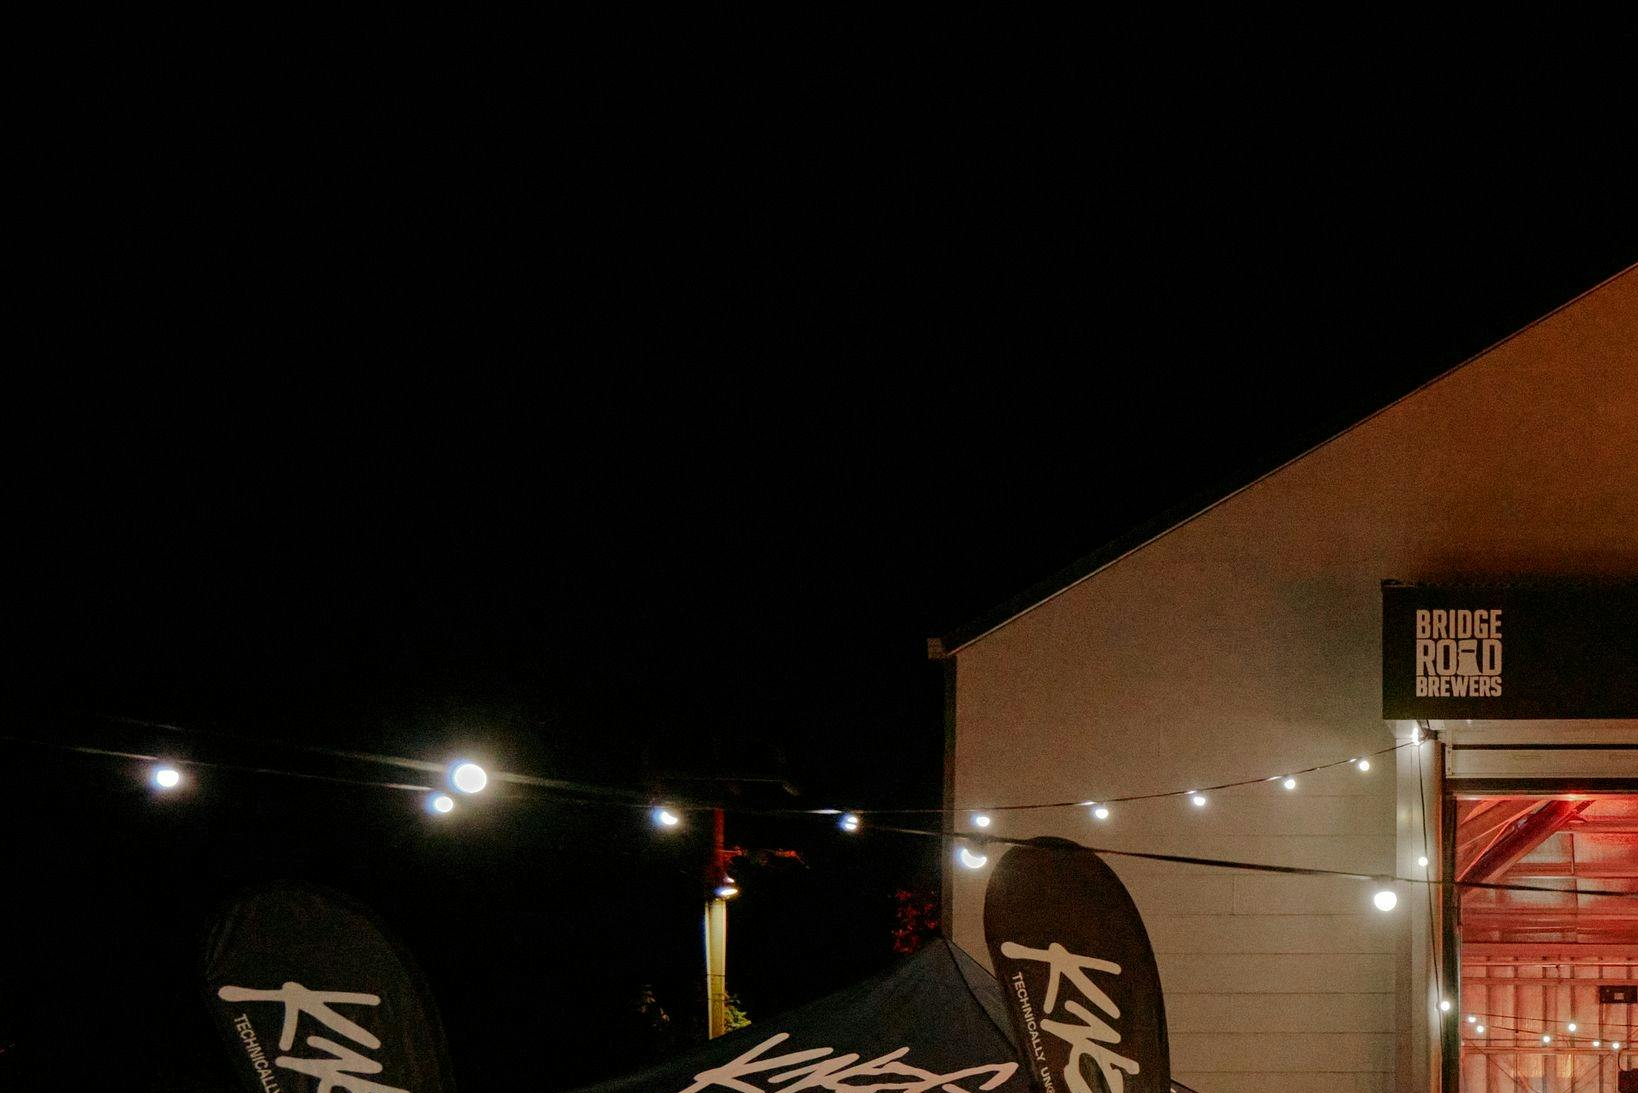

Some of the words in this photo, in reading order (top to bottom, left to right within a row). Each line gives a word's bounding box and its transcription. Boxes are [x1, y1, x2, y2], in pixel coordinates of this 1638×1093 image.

[1416, 609, 1502, 639] BRIDGE
[1416, 640, 1502, 675] ROAD
[1416, 677, 1502, 698] BREWERS
[1012, 972, 1047, 1062] TECHNICALLY
